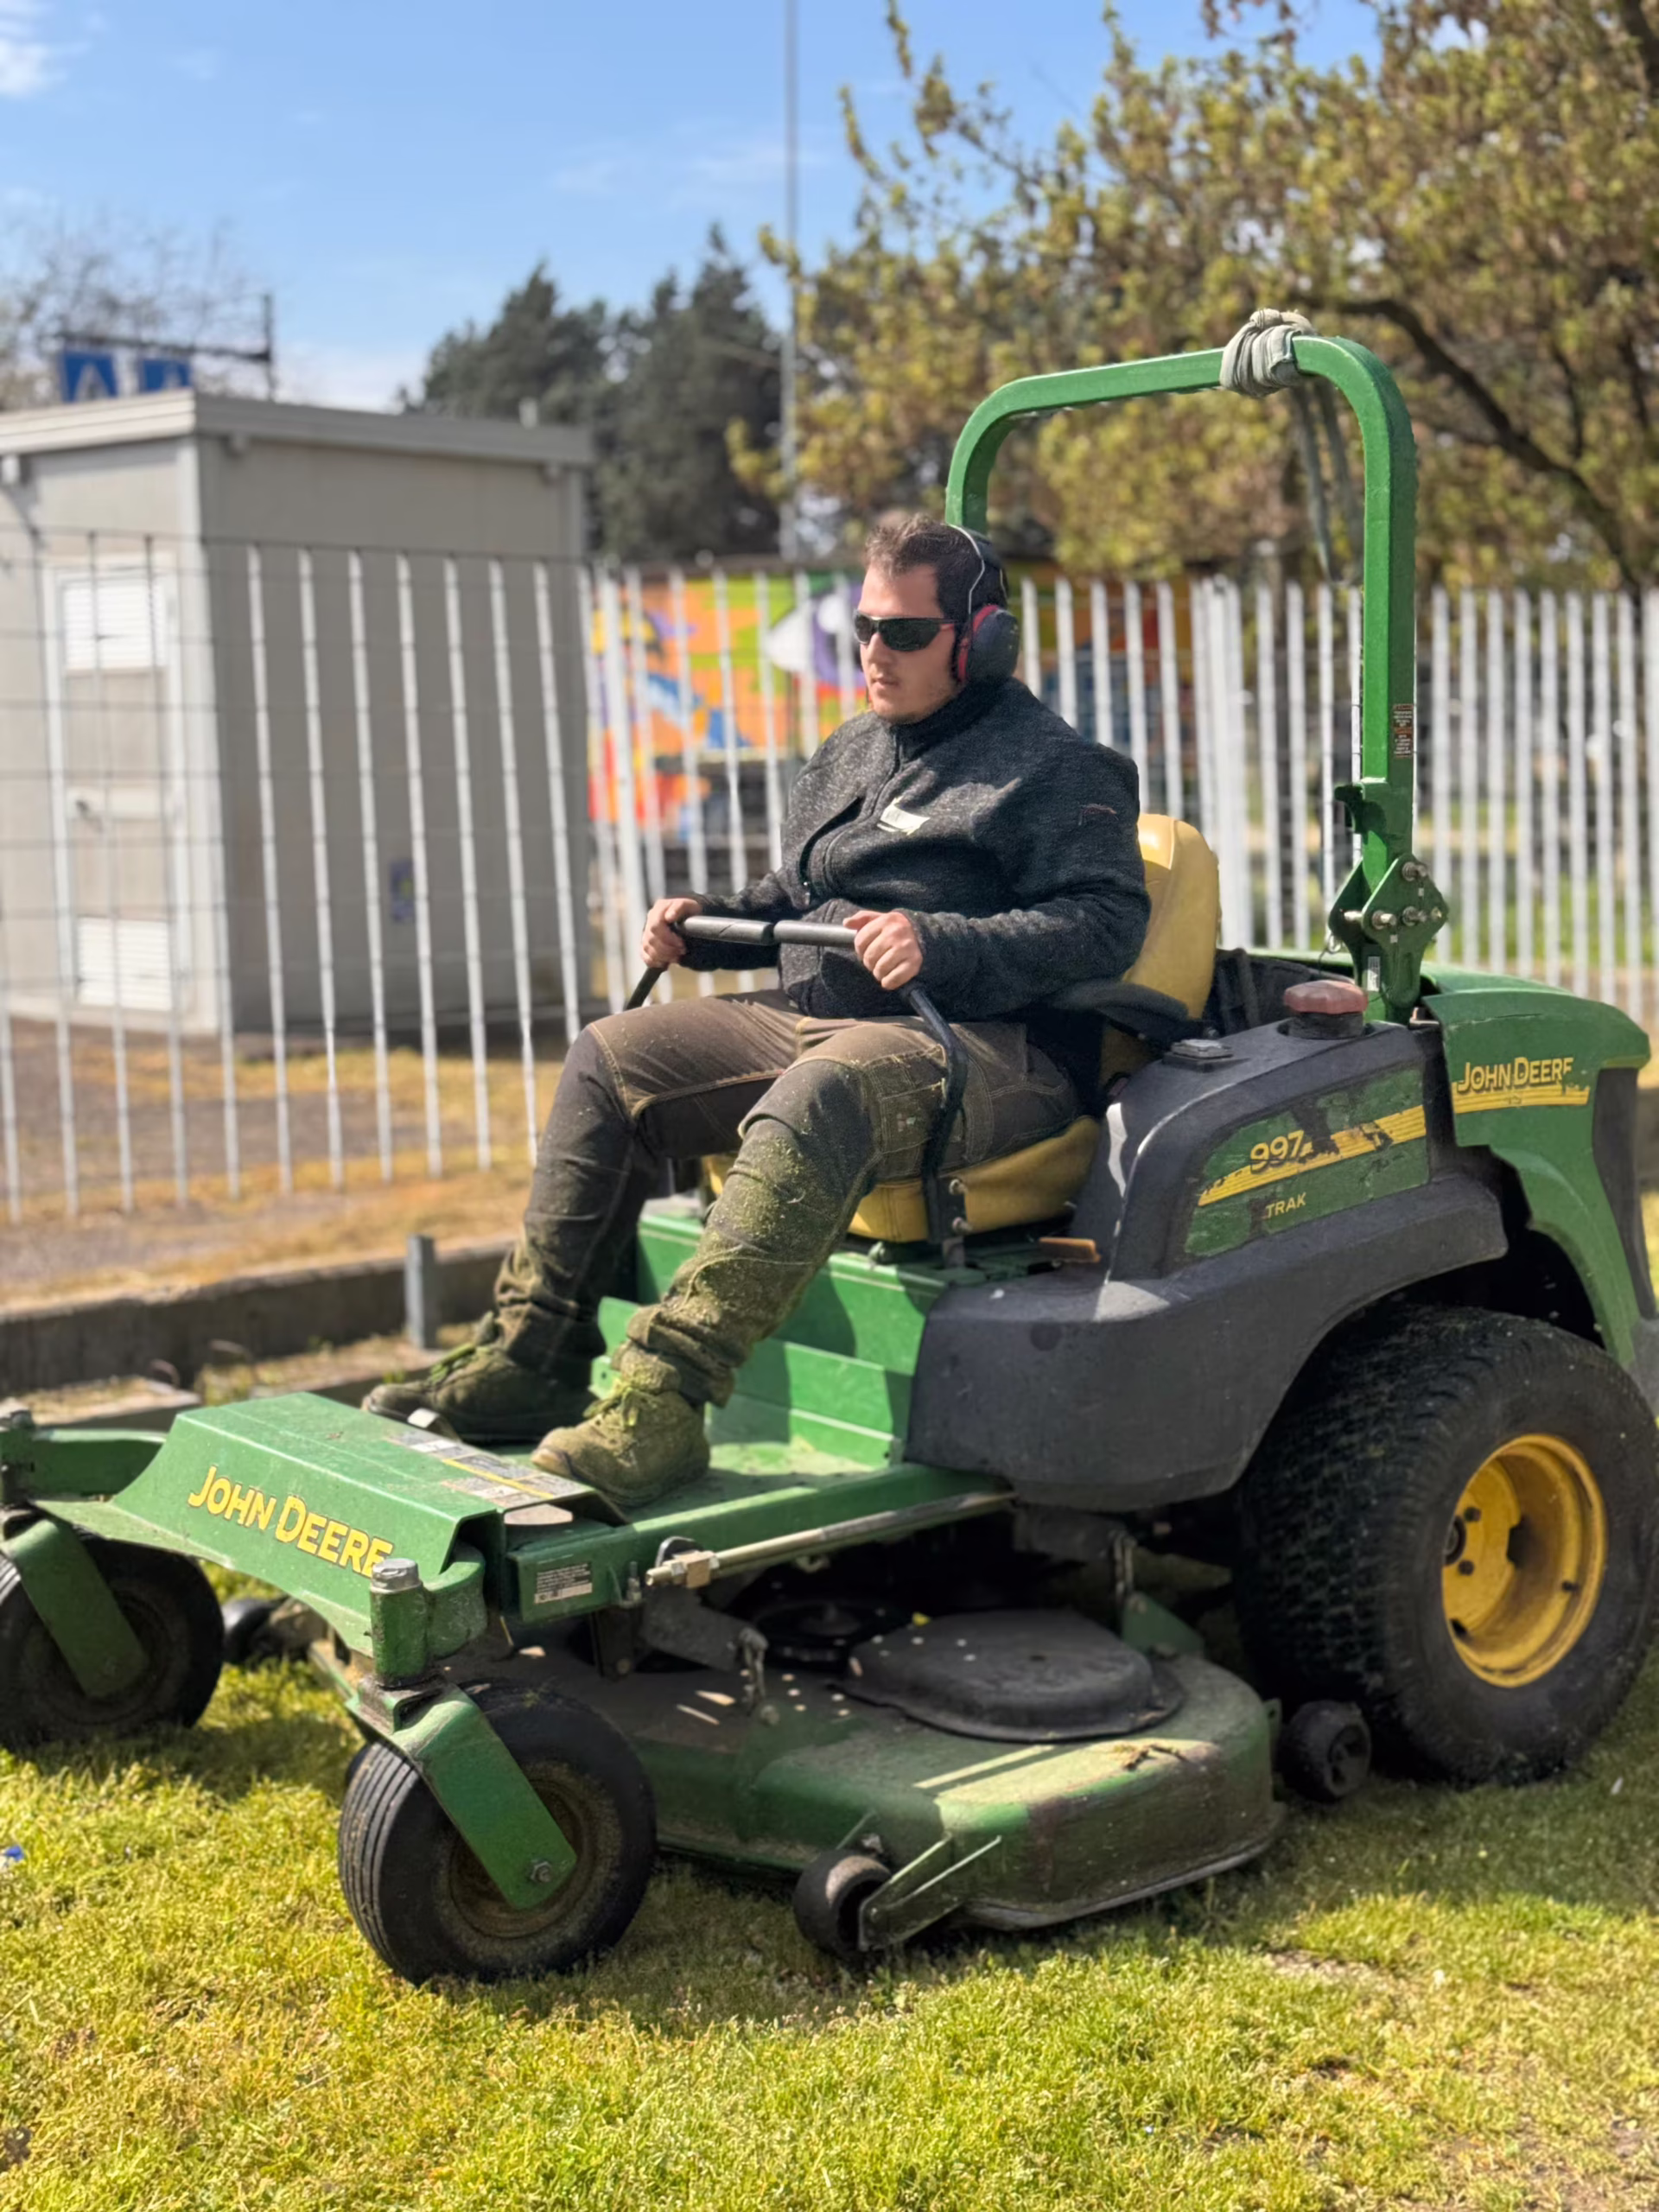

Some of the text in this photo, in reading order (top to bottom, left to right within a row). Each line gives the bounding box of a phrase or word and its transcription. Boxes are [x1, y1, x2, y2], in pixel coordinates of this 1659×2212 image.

[1458, 1062, 1511, 1092] JOHN
[1265, 1192, 1306, 1219] TRAK
[188, 1465, 395, 1580] JOHN DEERE
